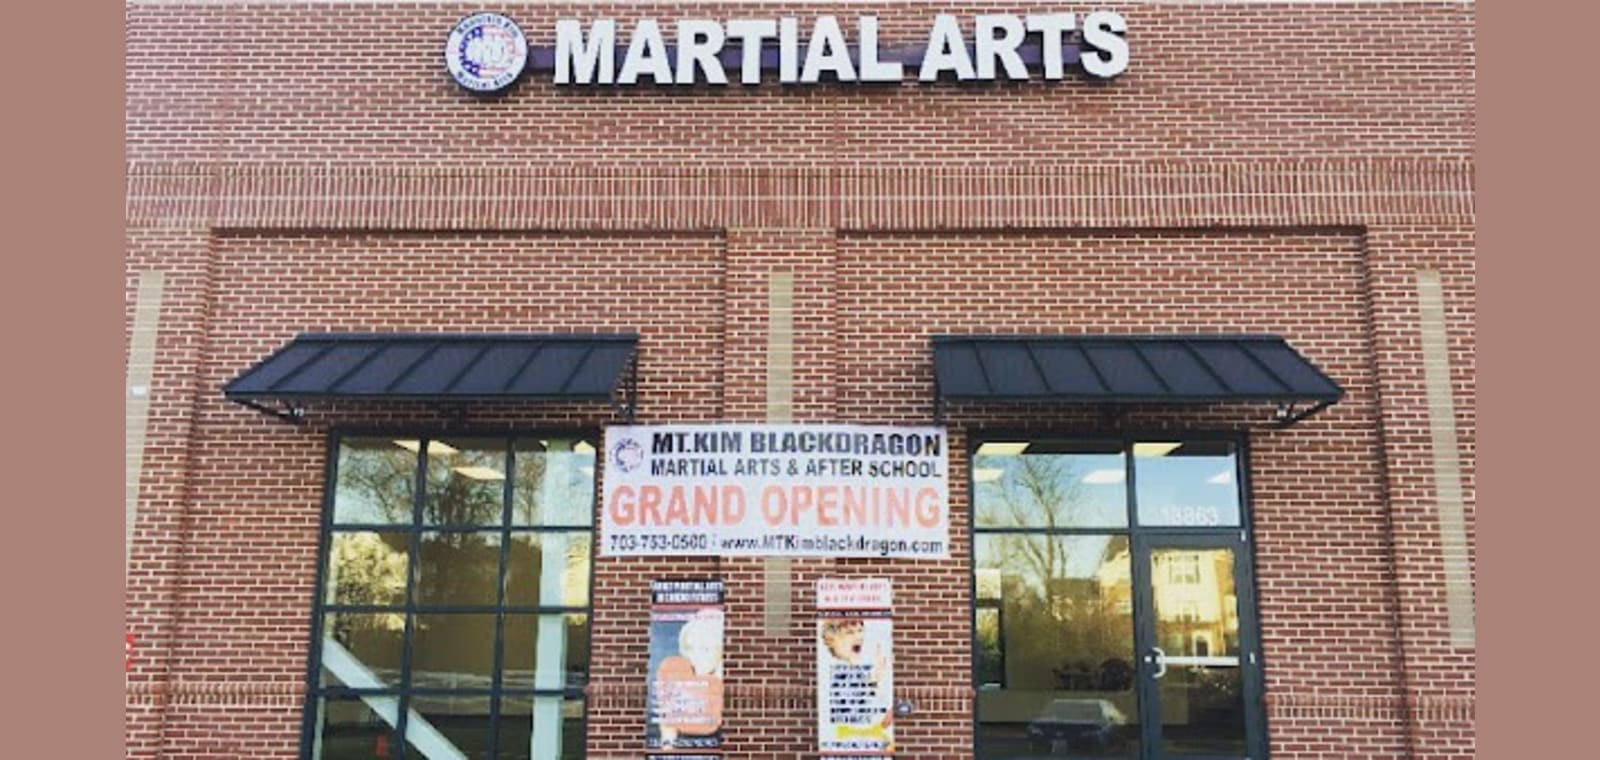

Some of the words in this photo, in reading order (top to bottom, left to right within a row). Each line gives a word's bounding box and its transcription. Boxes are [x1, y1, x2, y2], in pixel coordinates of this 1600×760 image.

[554, 17, 902, 85] MARTIAL
[918, 11, 1130, 81] ARTS
[651, 432, 742, 454] MT.KIM
[750, 432, 942, 457] BLACKDRAGON
[651, 459, 727, 476] MARTIAL
[734, 460, 781, 477] ARTS
[786, 462, 799, 476] &
[806, 461, 863, 477] AFTER
[868, 461, 942, 478] SCHOOL
[609, 484, 746, 527] GRAND
[760, 485, 941, 529] OPENING
